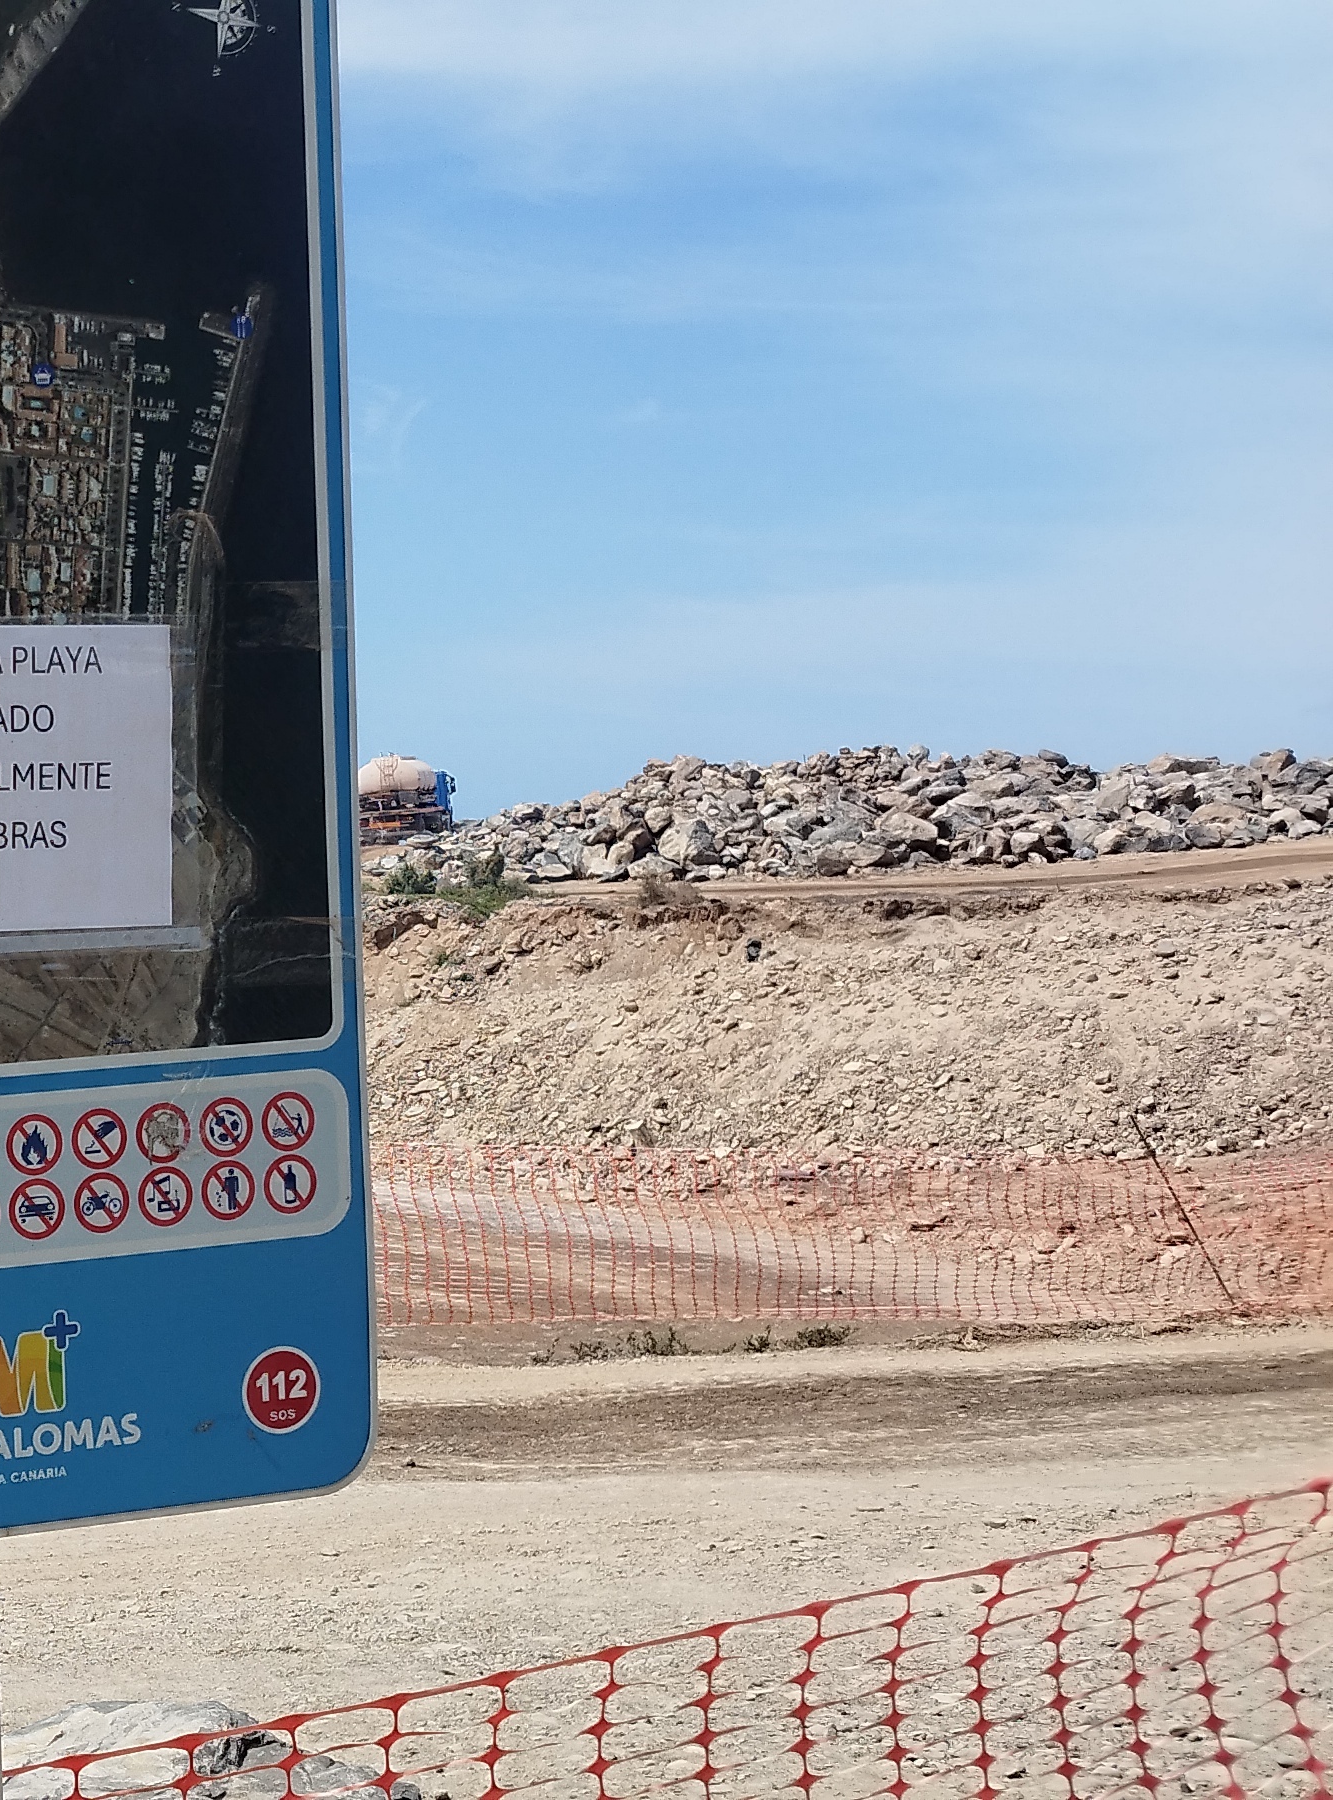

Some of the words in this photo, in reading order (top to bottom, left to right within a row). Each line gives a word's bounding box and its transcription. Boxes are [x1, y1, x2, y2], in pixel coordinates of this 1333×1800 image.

[12, 646, 103, 674] PLAYA
[256, 1369, 308, 1402] 112
[270, 1409, 297, 1421] SOS
[10, 1466, 68, 1484] CANARIA
